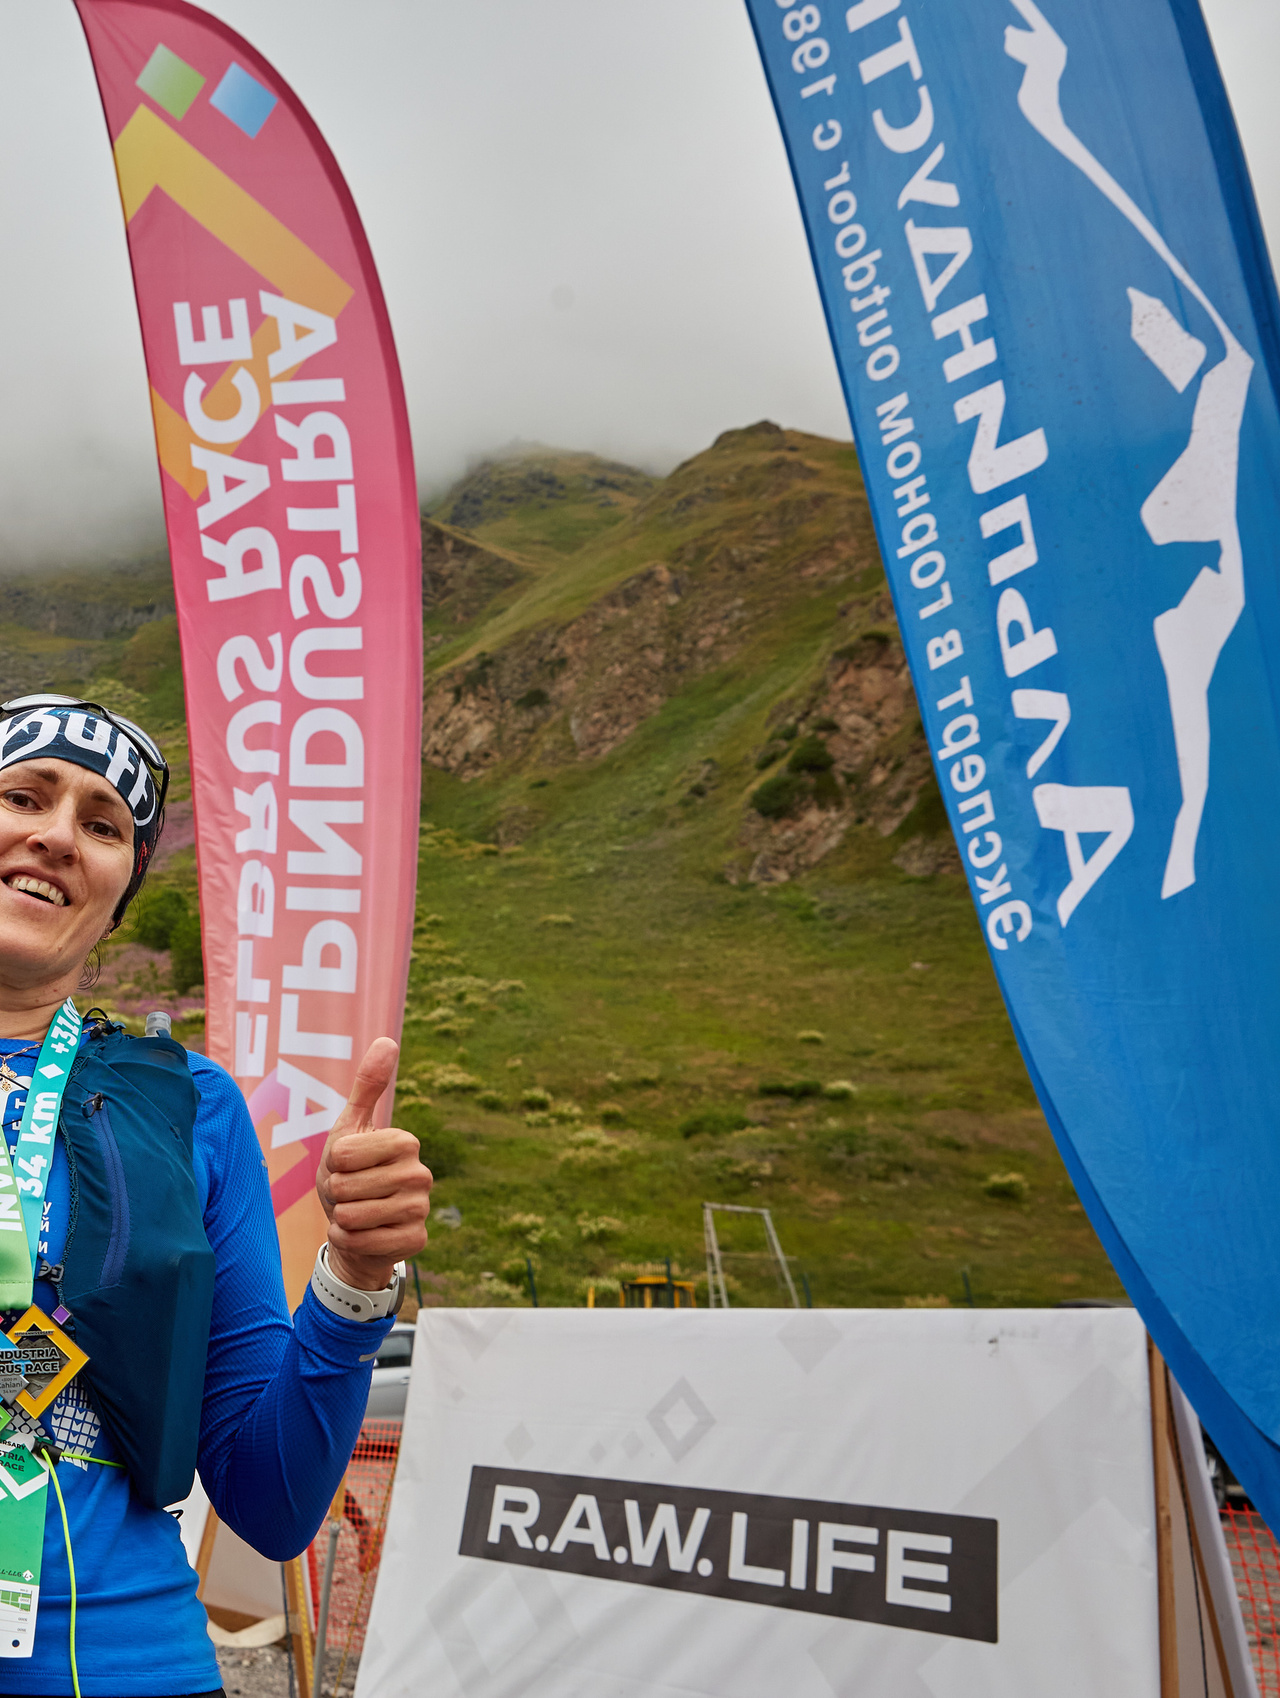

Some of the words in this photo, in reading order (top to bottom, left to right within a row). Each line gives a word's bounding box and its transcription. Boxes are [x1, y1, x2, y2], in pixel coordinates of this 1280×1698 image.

[21, 1091, 59, 1145] km
[15, 1154, 48, 1198] 34
[24, 1361, 60, 1374] RACE
